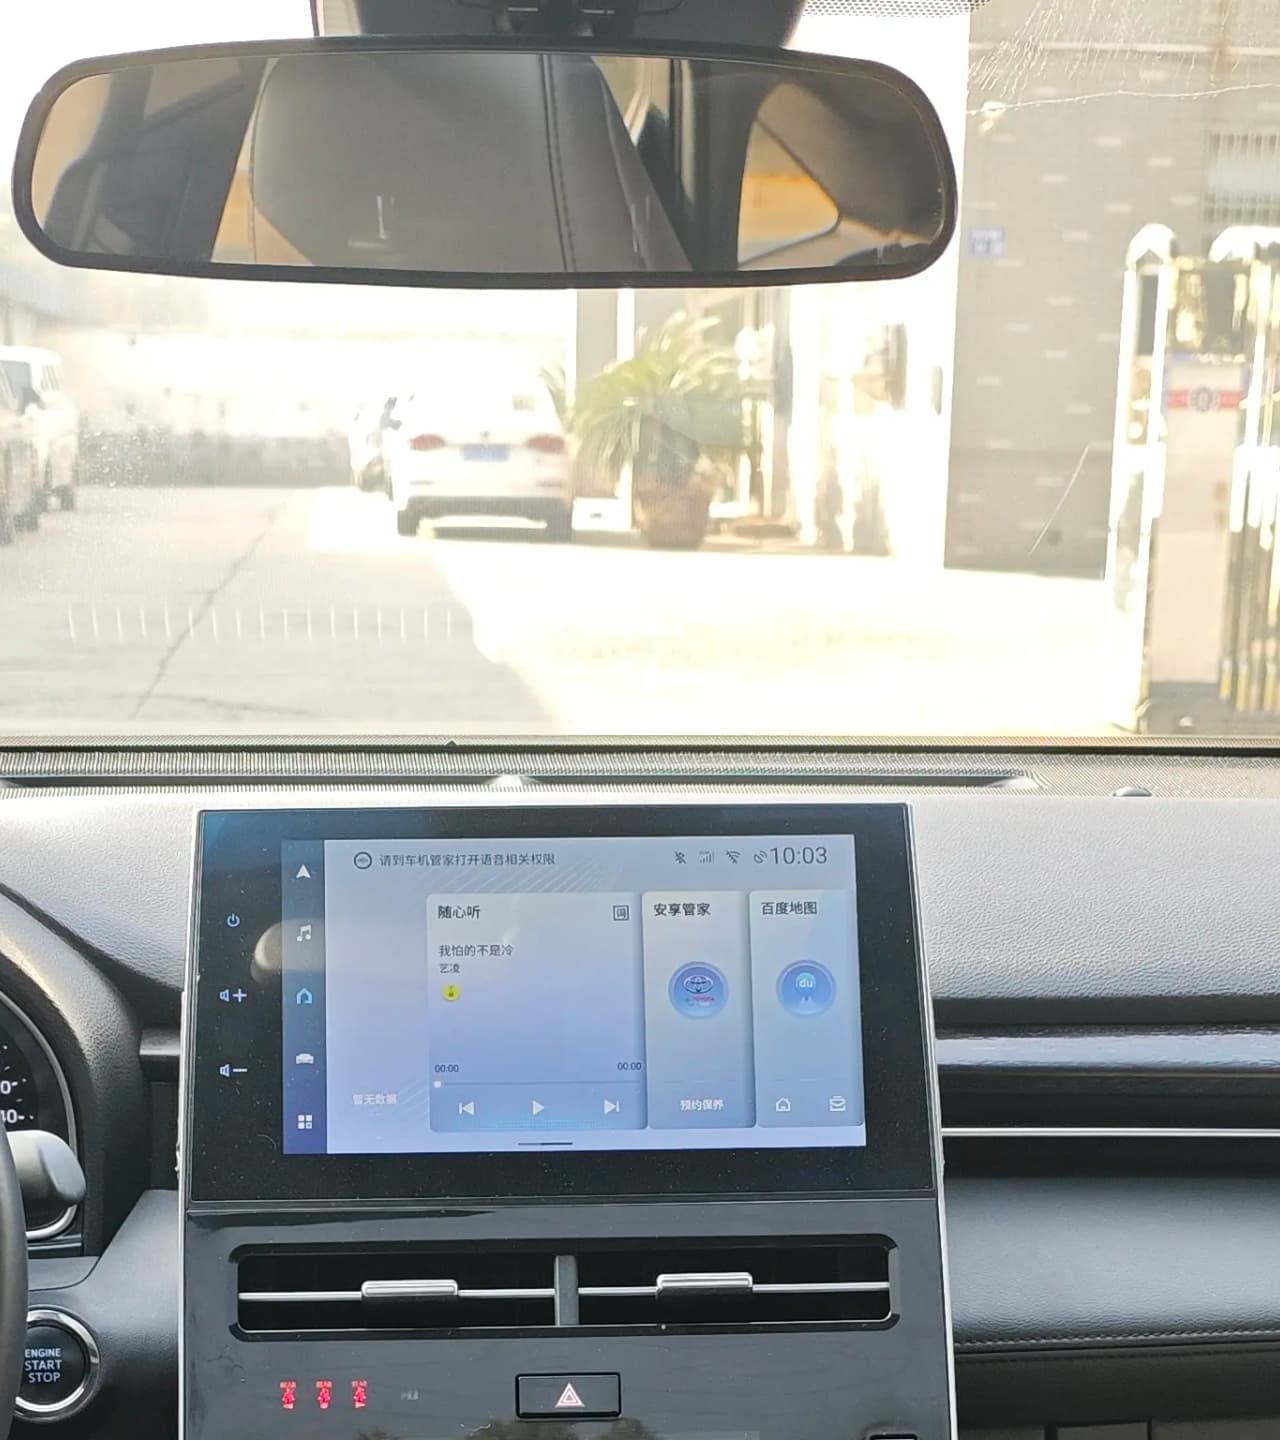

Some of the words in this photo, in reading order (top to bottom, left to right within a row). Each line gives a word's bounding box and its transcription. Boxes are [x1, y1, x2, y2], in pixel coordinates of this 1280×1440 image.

[379, 853, 556, 867] 请到车机管家打开语音相关权限
[770, 846, 828, 865] 10:03
[437, 905, 480, 920] 随心听
[653, 902, 712, 917] 安享管家
[761, 901, 818, 916] 百度地图
[438, 944, 514, 958] 我怕的不是冷
[438, 963, 461, 974] 艺凌
[434, 1064, 459, 1073] 00:00
[617, 1062, 642, 1071] 00:00
[679, 1099, 724, 1111] 预约保养
[24, 1348, 62, 1358] ENGINE
[24, 1359, 62, 1371] START
[28, 1371, 61, 1383] STOP
